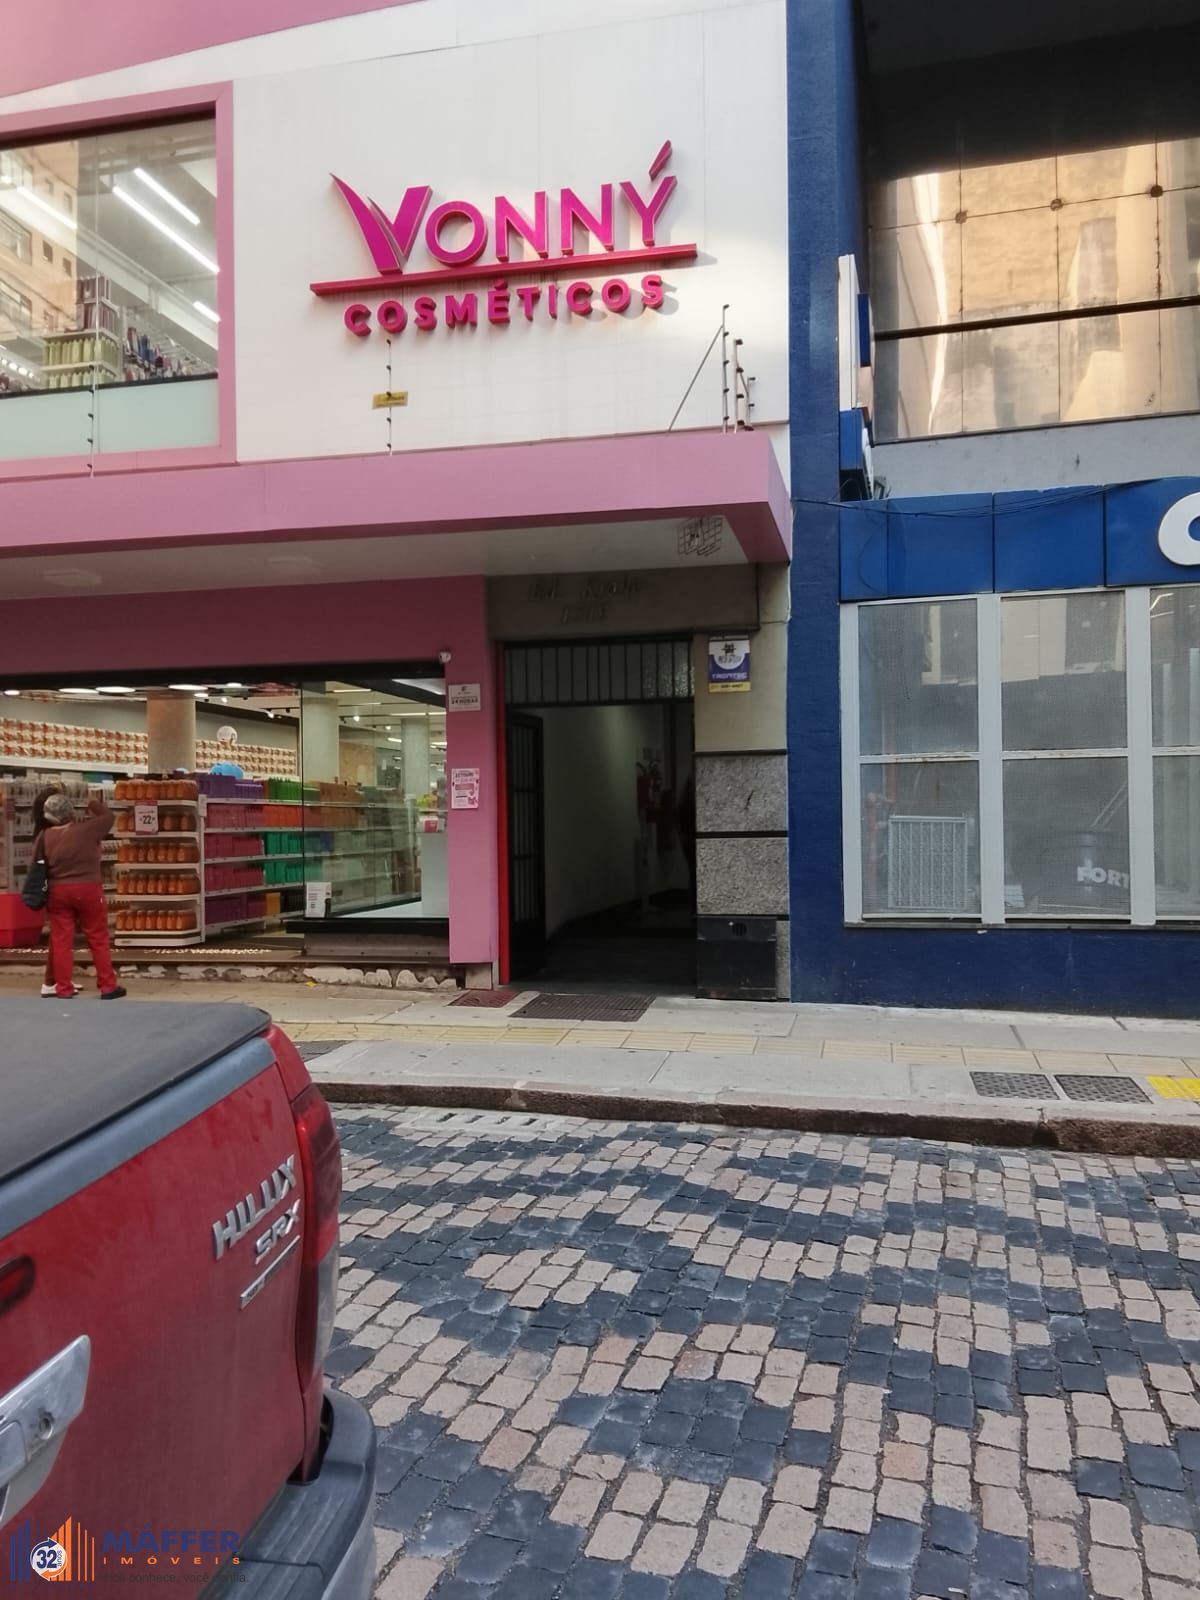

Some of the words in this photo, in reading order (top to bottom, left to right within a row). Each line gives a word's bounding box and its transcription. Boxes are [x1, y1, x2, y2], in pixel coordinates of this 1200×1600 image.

[344, 275, 664, 337] COSMÉTICOS
[213, 1154, 297, 1261] HILUX
[256, 1199, 301, 1265] SRX
